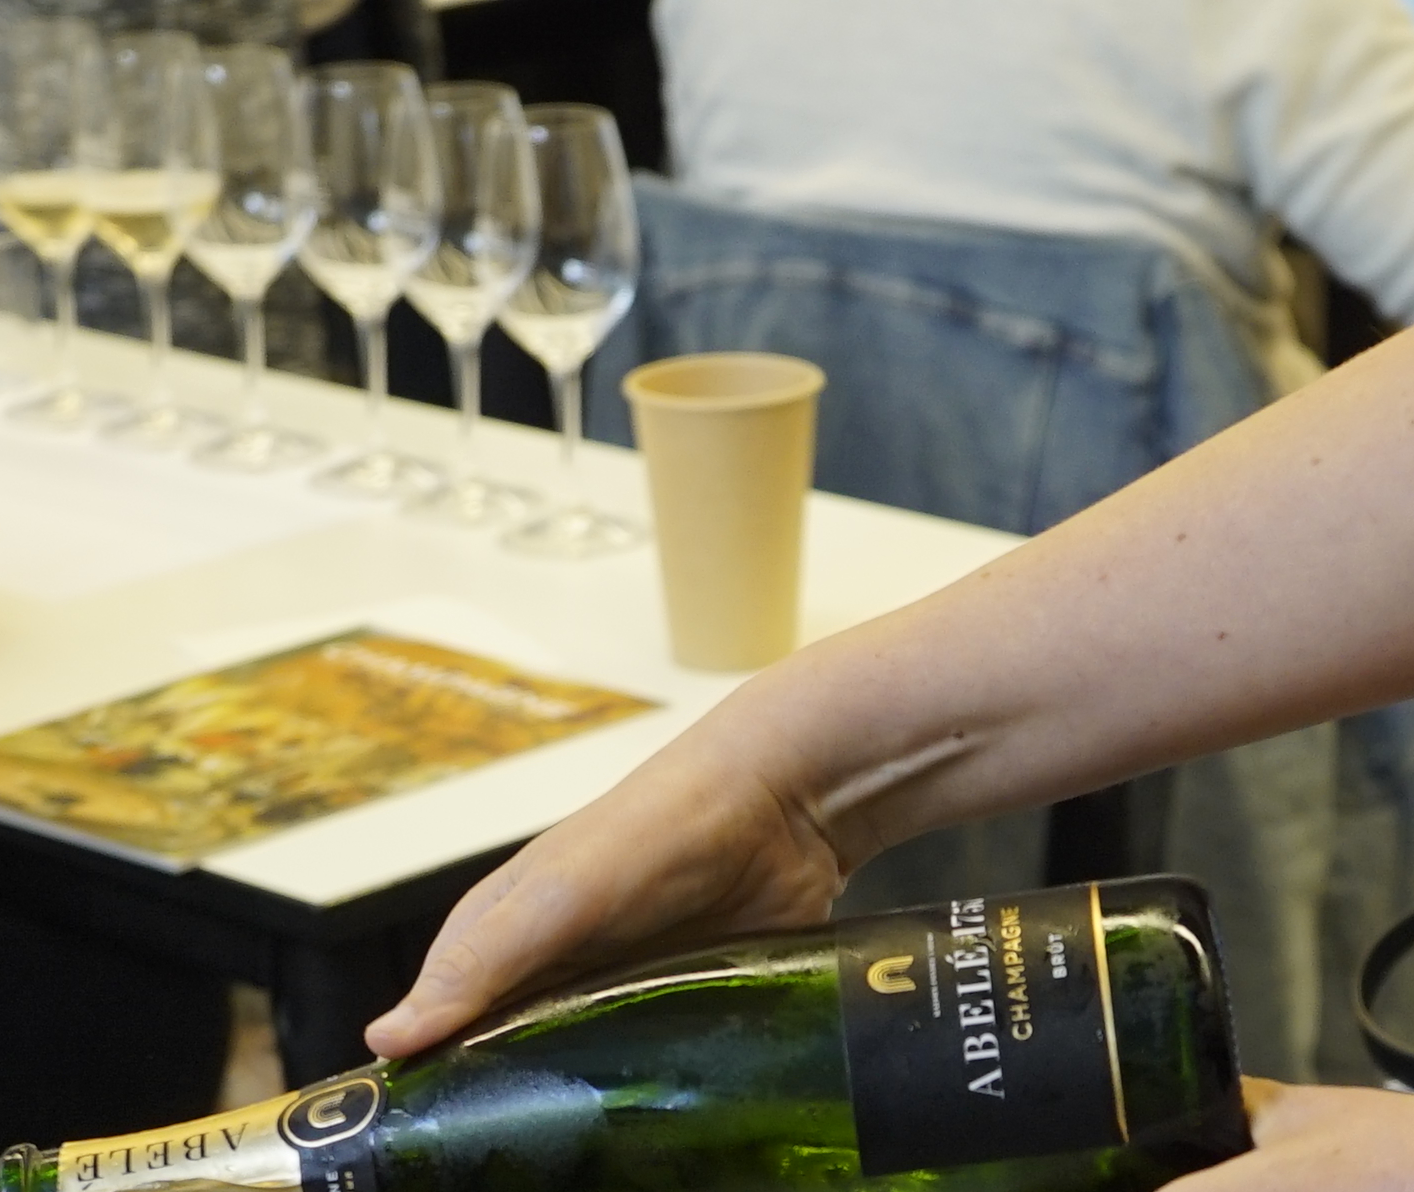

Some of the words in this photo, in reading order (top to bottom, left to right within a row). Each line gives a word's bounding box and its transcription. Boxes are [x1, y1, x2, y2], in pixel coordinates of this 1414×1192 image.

[945, 945, 1005, 1100] ABELÉ
[1000, 906, 1033, 1041] CHAMPAGNE
[76, 1122, 249, 1191] ABELÉ
